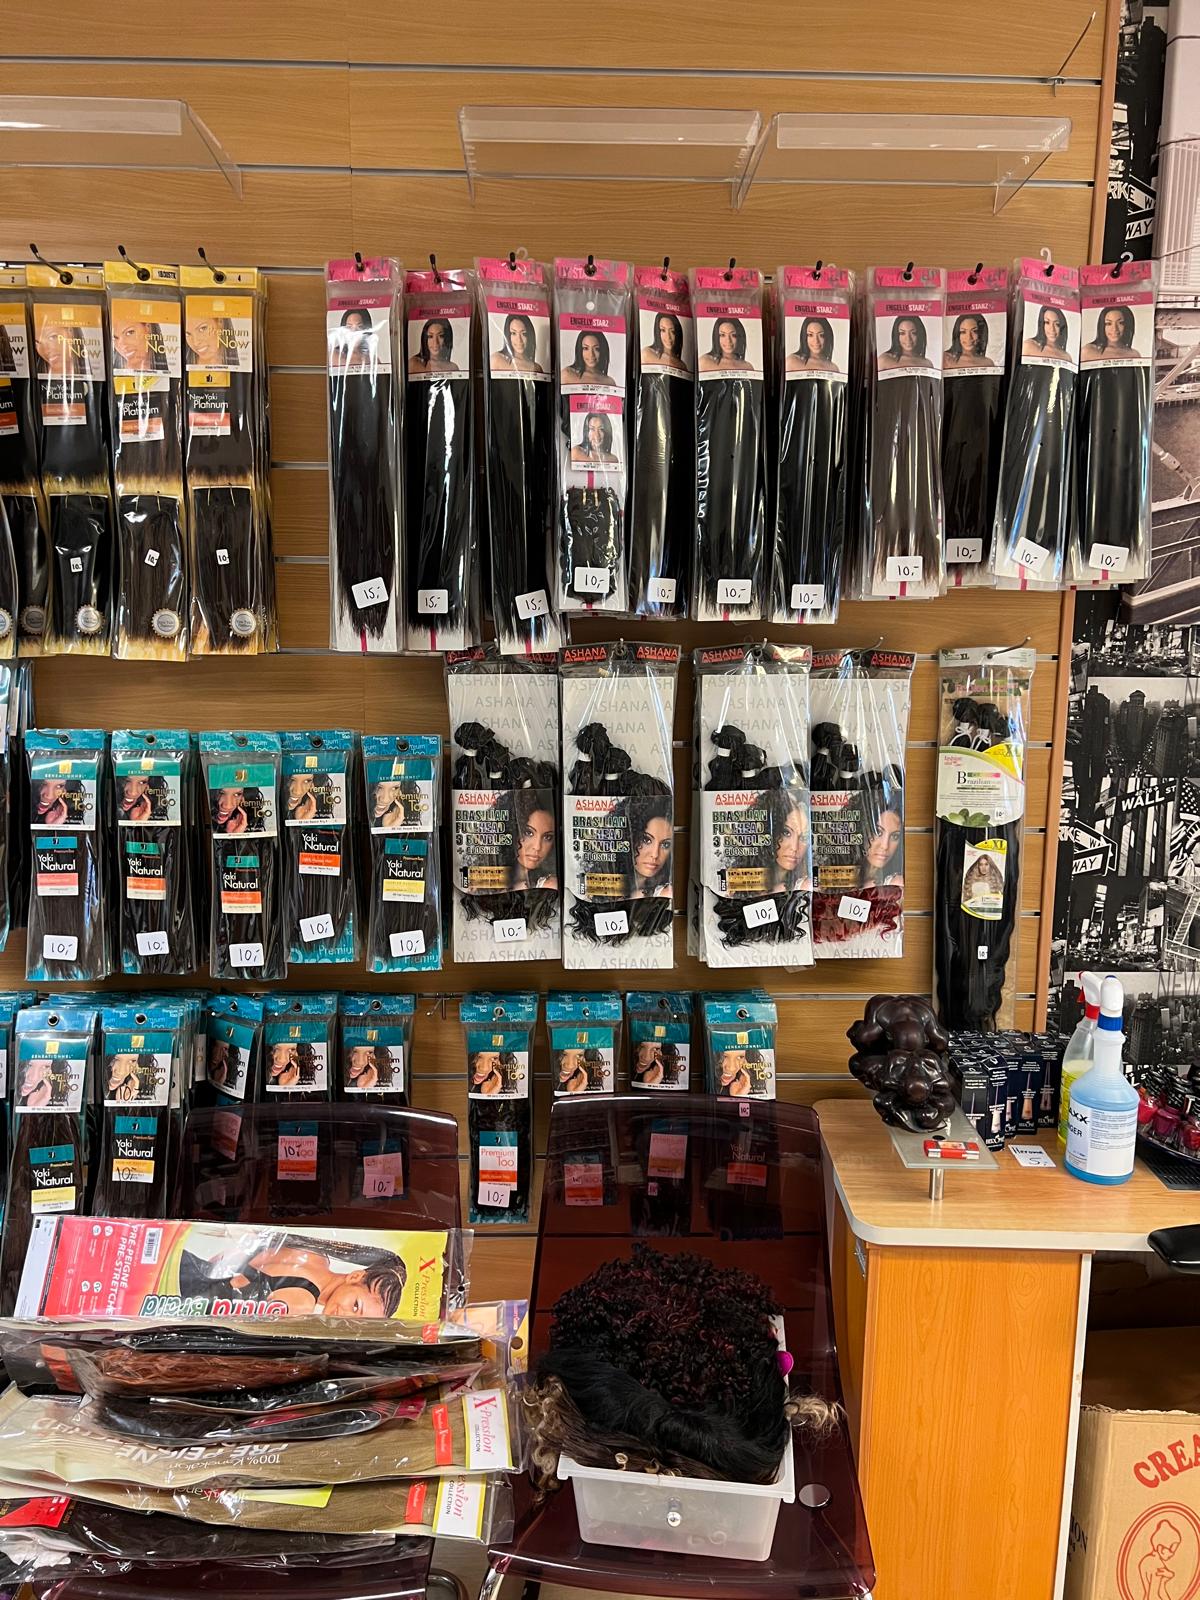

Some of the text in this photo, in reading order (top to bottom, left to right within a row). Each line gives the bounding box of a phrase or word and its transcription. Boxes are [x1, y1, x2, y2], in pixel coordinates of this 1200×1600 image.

[58, 335, 100, 346] Premium
[217, 337, 249, 349] Now
[69, 345, 101, 358] Now
[146, 341, 178, 354] Now
[205, 393, 218, 401] Yaki
[193, 400, 229, 409] Platinum
[564, 647, 607, 658] ASHANA
[637, 646, 679, 657] ASHANA
[702, 648, 745, 659] ASHANA
[812, 654, 843, 665] SHANA
[872, 653, 912, 664] ASHANA
[157, 796, 176, 807] Too
[322, 793, 342, 805] Too
[459, 793, 497, 801] ASHANA
[716, 794, 755, 802] ASHANA
[811, 794, 848, 803] ASHANA
[1121, 790, 1165, 812] WALL
[1165, 785, 1177, 794] ST
[74, 799, 93, 811] Too
[409, 800, 429, 811] Too
[576, 800, 614, 808] ASHANA
[253, 807, 272, 817] Too
[455, 810, 509, 821] BRASILIAN
[713, 811, 767, 822] BRASILIAN
[455, 822, 505, 833] FULLHEAD
[573, 816, 627, 828] BRASILIAN
[573, 828, 623, 840] FULLHEAD
[713, 823, 764, 834] FULLHEAD
[302, 833, 318, 843] Yaki
[456, 834, 512, 845] 3 BUNDLES
[713, 835, 771, 846] 3 BUNDLES
[817, 834, 863, 845] BUNDLES
[304, 841, 339, 852] Natural
[573, 840, 630, 852] 3 BUNDLES
[38, 855, 54, 863] Yaki
[128, 858, 142, 866] Yaki
[387, 860, 402, 868] Yaki
[41, 860, 76, 871] Natural
[130, 865, 163, 876] Natural
[1073, 858, 1096, 872] WAY
[223, 873, 236, 881] Yaki
[389, 868, 423, 878] Natural
[224, 879, 258, 889] Natural
[489, 951, 546, 960] ASHANA
[600, 958, 658, 969] ASHANA
[508, 1071, 524, 1080] Too
[755, 1069, 772, 1080] Too
[116, 1140, 132, 1148] Yaki
[118, 1147, 153, 1158] Natural
[496, 1156, 515, 1166] Too
[33, 1169, 50, 1178] Yaki
[36, 1174, 73, 1187] Natural
[412, 1282, 420, 1317] COLLECTION
[247, 1454, 281, 1465] 100%
[445, 1480, 455, 1515] COLLECTION
